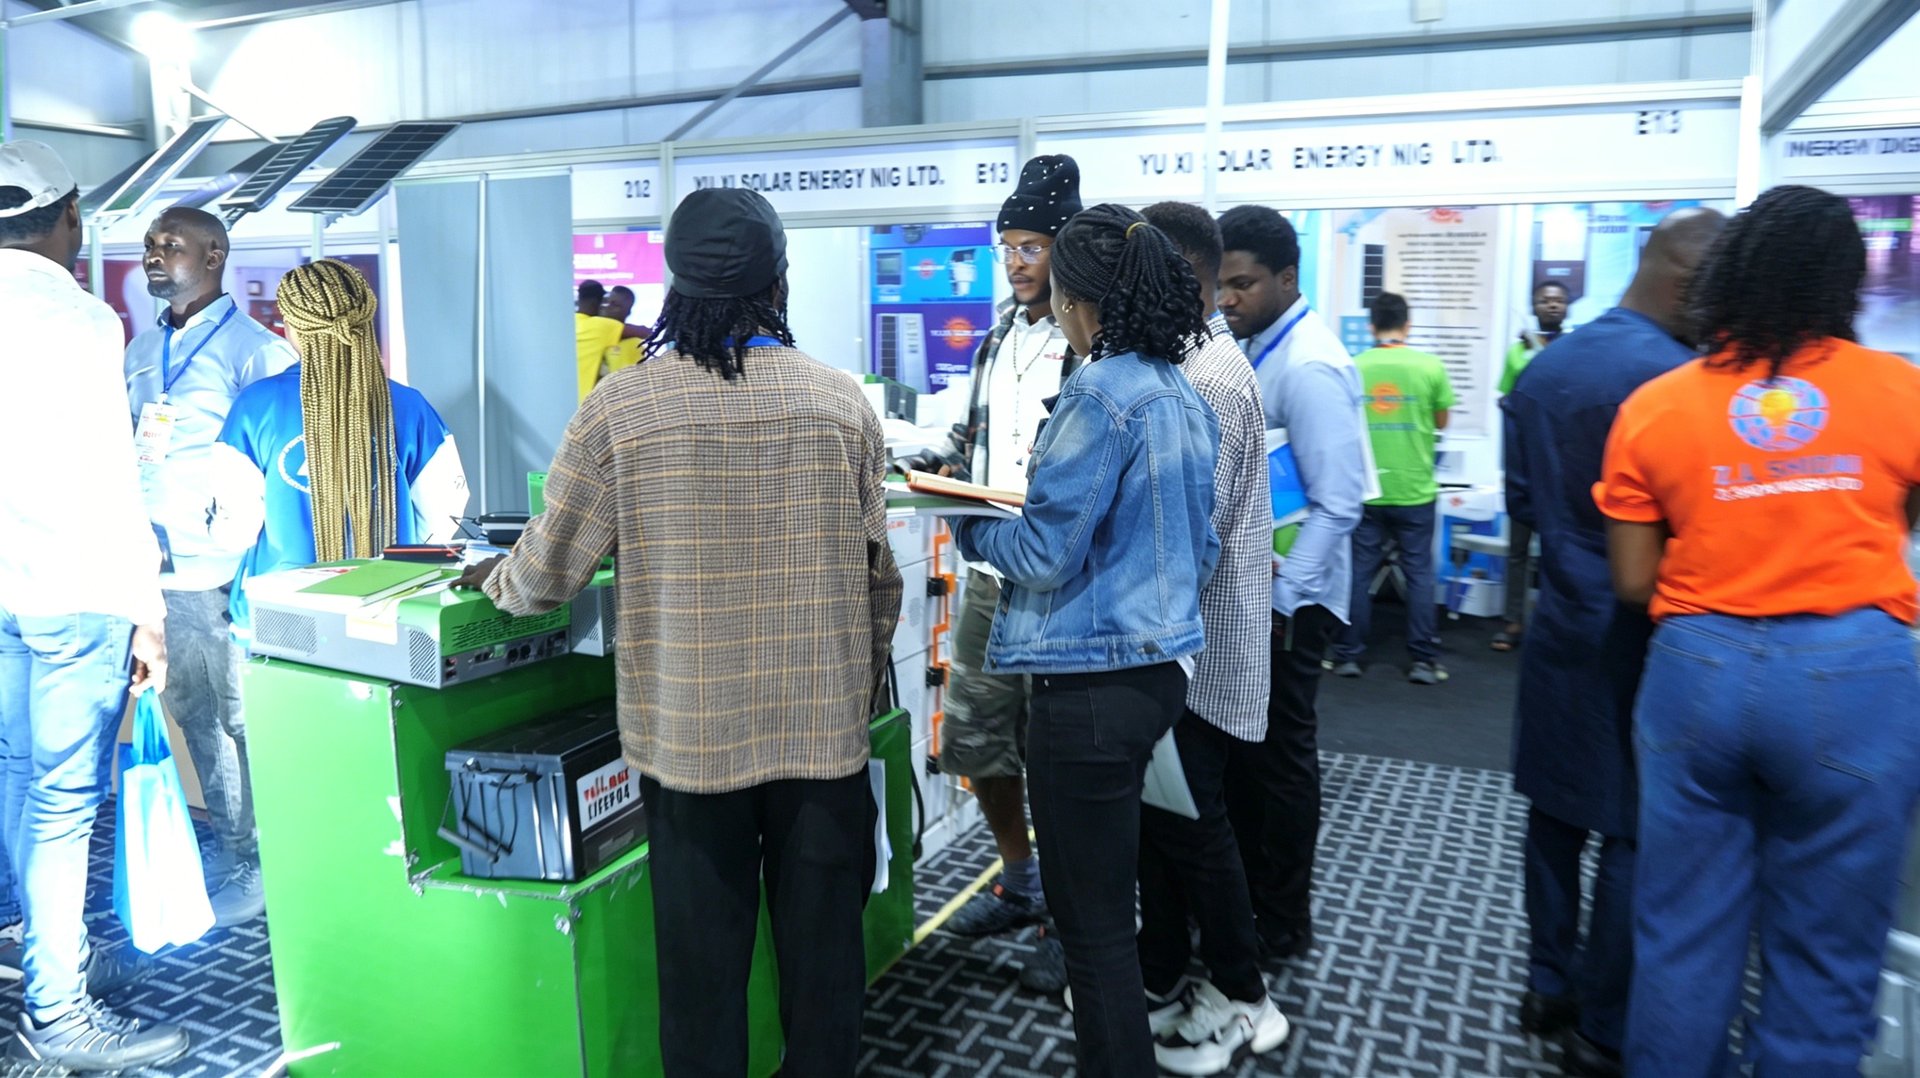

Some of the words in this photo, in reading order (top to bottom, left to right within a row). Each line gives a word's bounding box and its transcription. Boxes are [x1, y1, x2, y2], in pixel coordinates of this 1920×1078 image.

[1636, 110, 1681, 135] E13
[1139, 153, 1167, 175] YU
[1174, 152, 1194, 174] XI
[1203, 149, 1273, 173] OLAR
[1293, 144, 1383, 169] ENERGY
[1391, 143, 1432, 166] NIG
[741, 171, 793, 192] SOLAR
[798, 168, 864, 191] ENERGY
[870, 167, 900, 188] NIG
[907, 164, 945, 187] LTD.
[976, 162, 1009, 184] E13
[624, 179, 651, 199] 212
